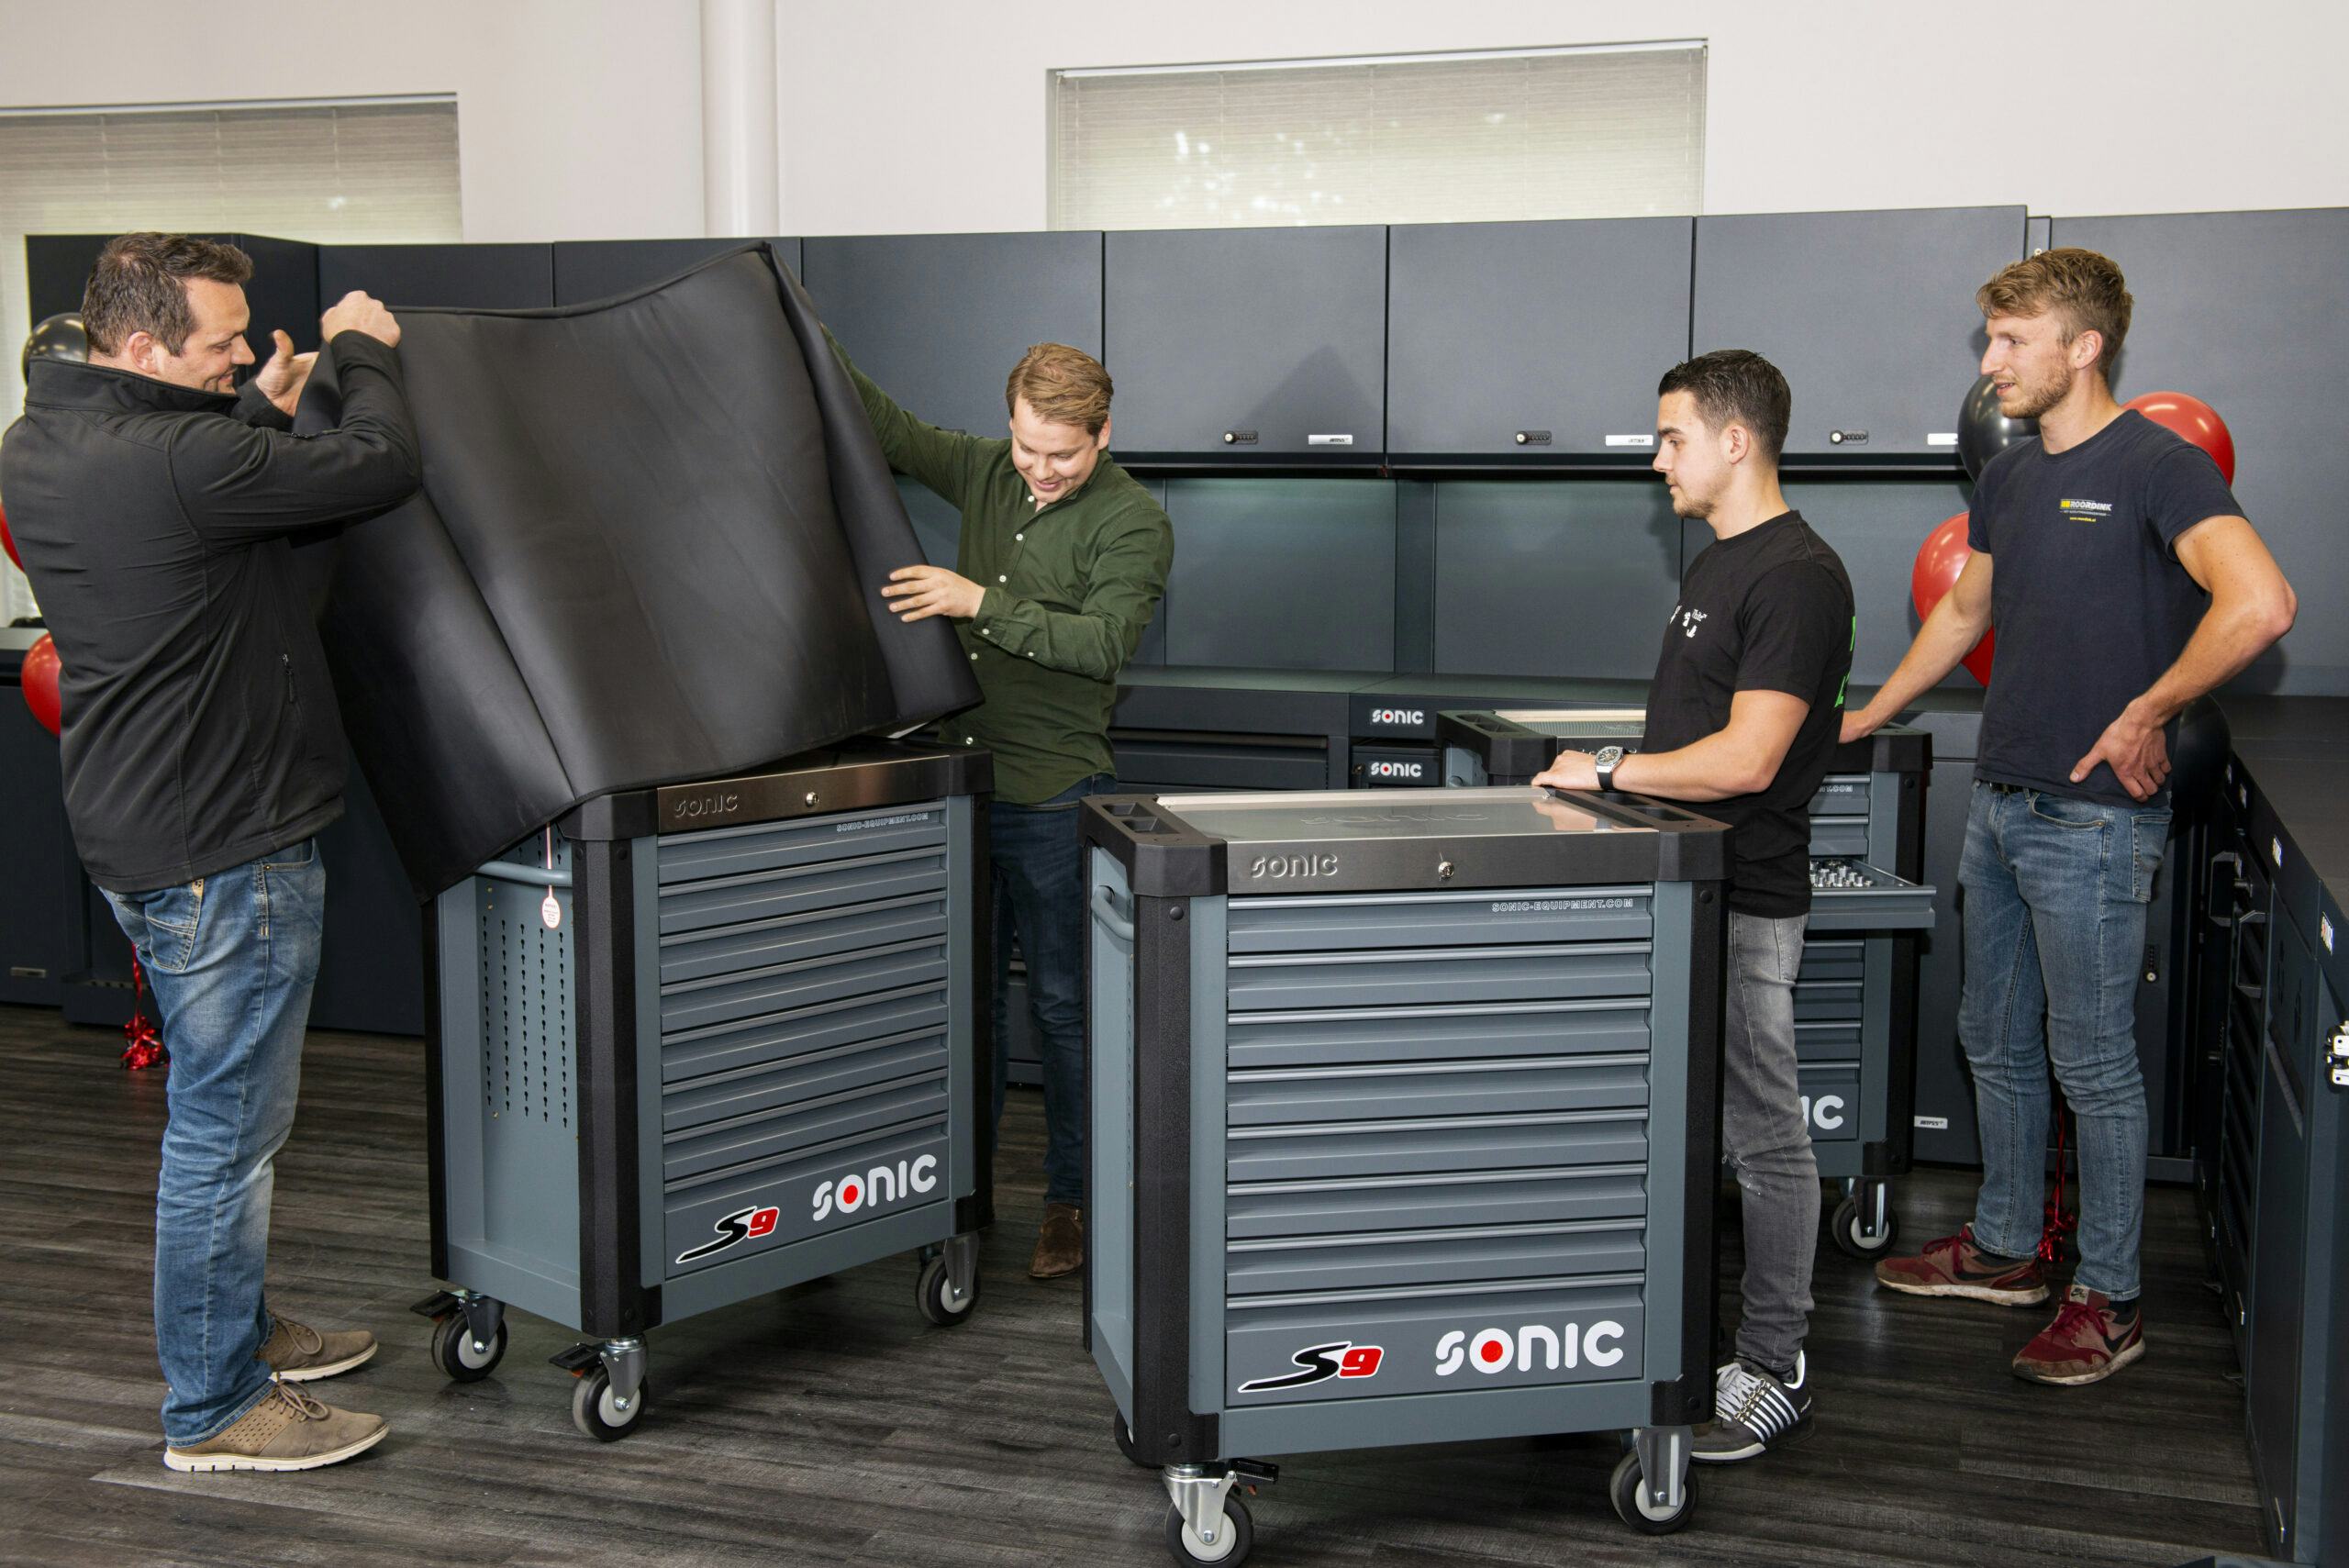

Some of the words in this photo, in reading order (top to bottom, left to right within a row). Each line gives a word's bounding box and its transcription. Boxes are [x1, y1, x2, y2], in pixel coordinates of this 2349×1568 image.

[1372, 709, 1423, 725] SONIC
[1371, 762, 1421, 777] SONIC
[836, 813, 929, 832] SONIC-EQUIPMENT.COM
[1491, 898, 1633, 912] SONIC-EQUIPMENT.COM
[813, 1154, 936, 1221] SONIC
[675, 1206, 780, 1263] S9
[1436, 1321, 1624, 1375] SONIC
[1238, 1341, 1384, 1393] S9
